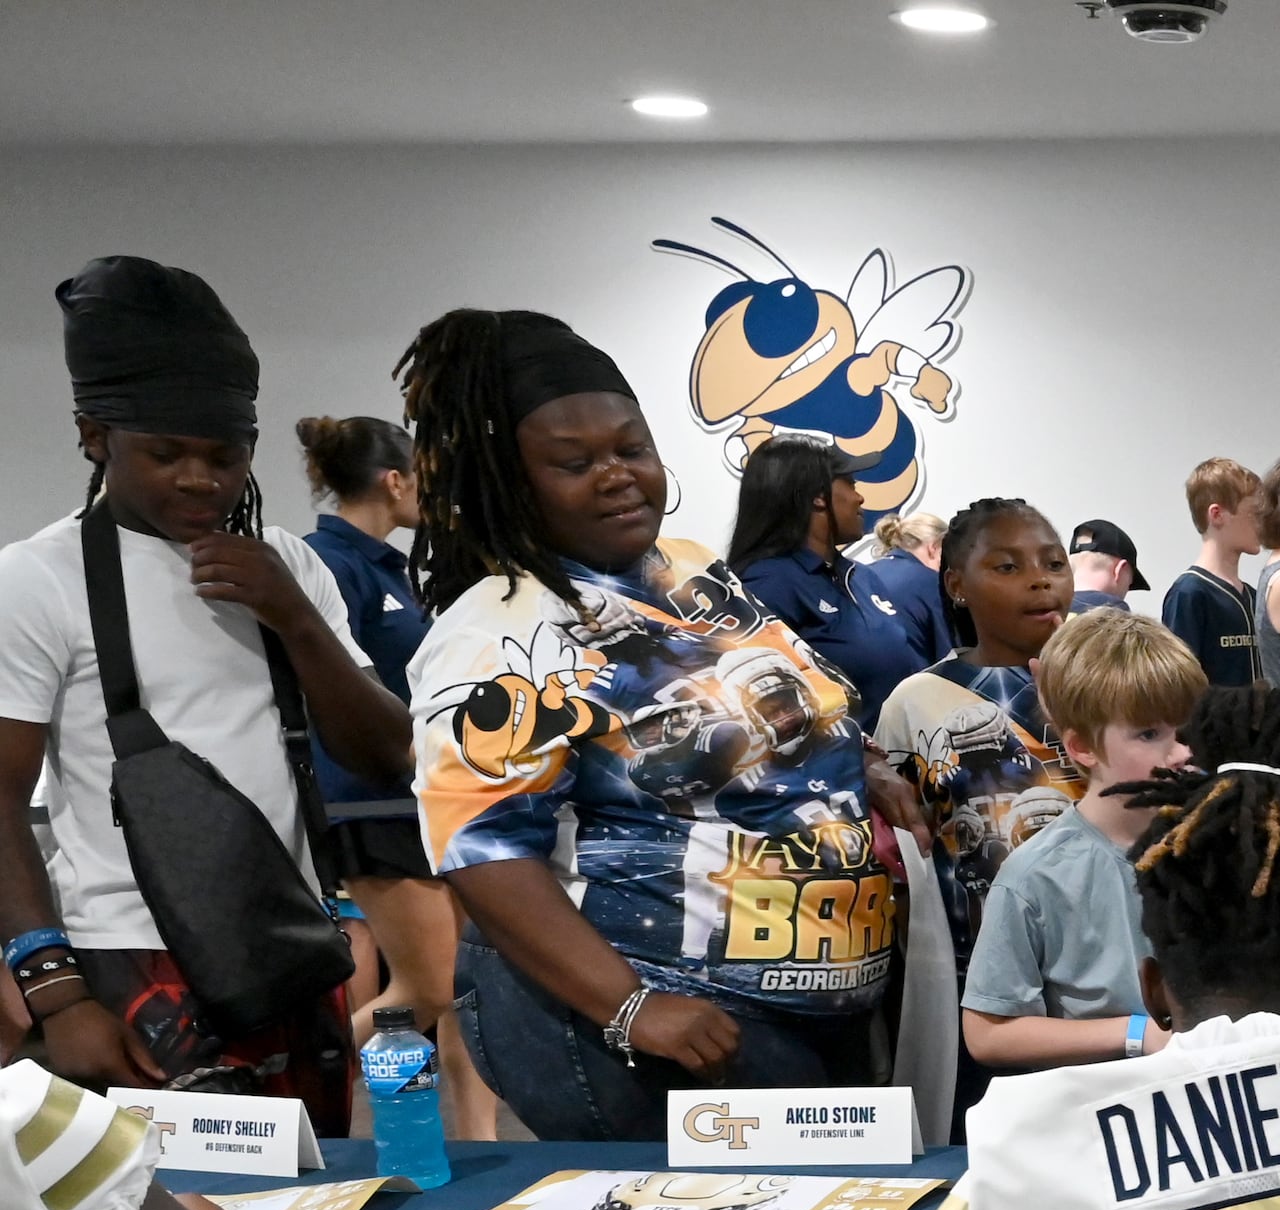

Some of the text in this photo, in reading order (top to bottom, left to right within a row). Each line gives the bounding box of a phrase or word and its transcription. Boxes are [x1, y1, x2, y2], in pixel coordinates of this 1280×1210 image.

[760, 966, 858, 991] GEORGIA
[367, 1051, 424, 1065] POWER
[369, 1065, 400, 1078] ADE
[786, 1106, 876, 1124] AKELO STONE
[192, 1118, 276, 1138] RODNEY SHELLEY
[683, 1102, 759, 1150] GT
[800, 1129, 865, 1138] #7 DEFENSIVE LINE
[205, 1142, 263, 1154] #6 DEFENSIVE BACK
